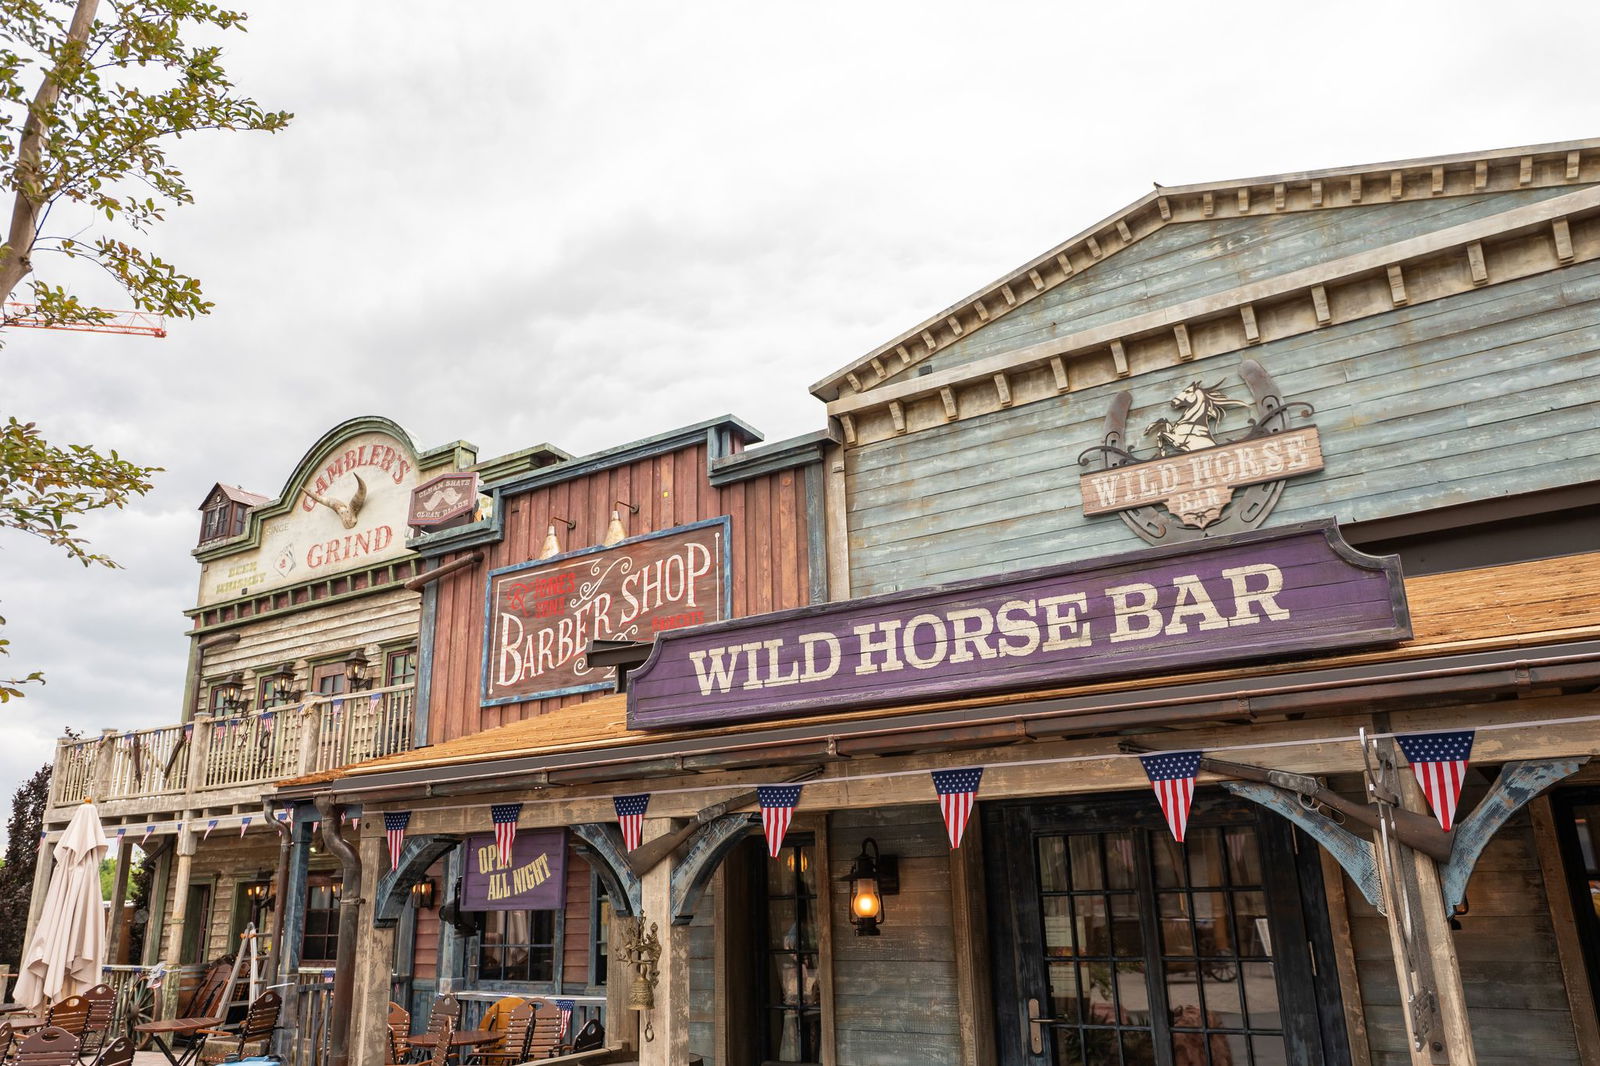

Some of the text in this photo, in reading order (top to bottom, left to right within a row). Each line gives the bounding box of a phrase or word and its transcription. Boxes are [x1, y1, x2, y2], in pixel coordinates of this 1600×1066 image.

[302, 444, 410, 512] GAMBLER'S
[1091, 436, 1309, 507] WILD HORSE
[1177, 489, 1220, 511] BAR
[306, 525, 393, 569] GRIND
[496, 543, 711, 686] BARBER SHOP
[689, 562, 1291, 697] WILD HORSE BAR
[487, 852, 552, 901] ALL NIGHT
